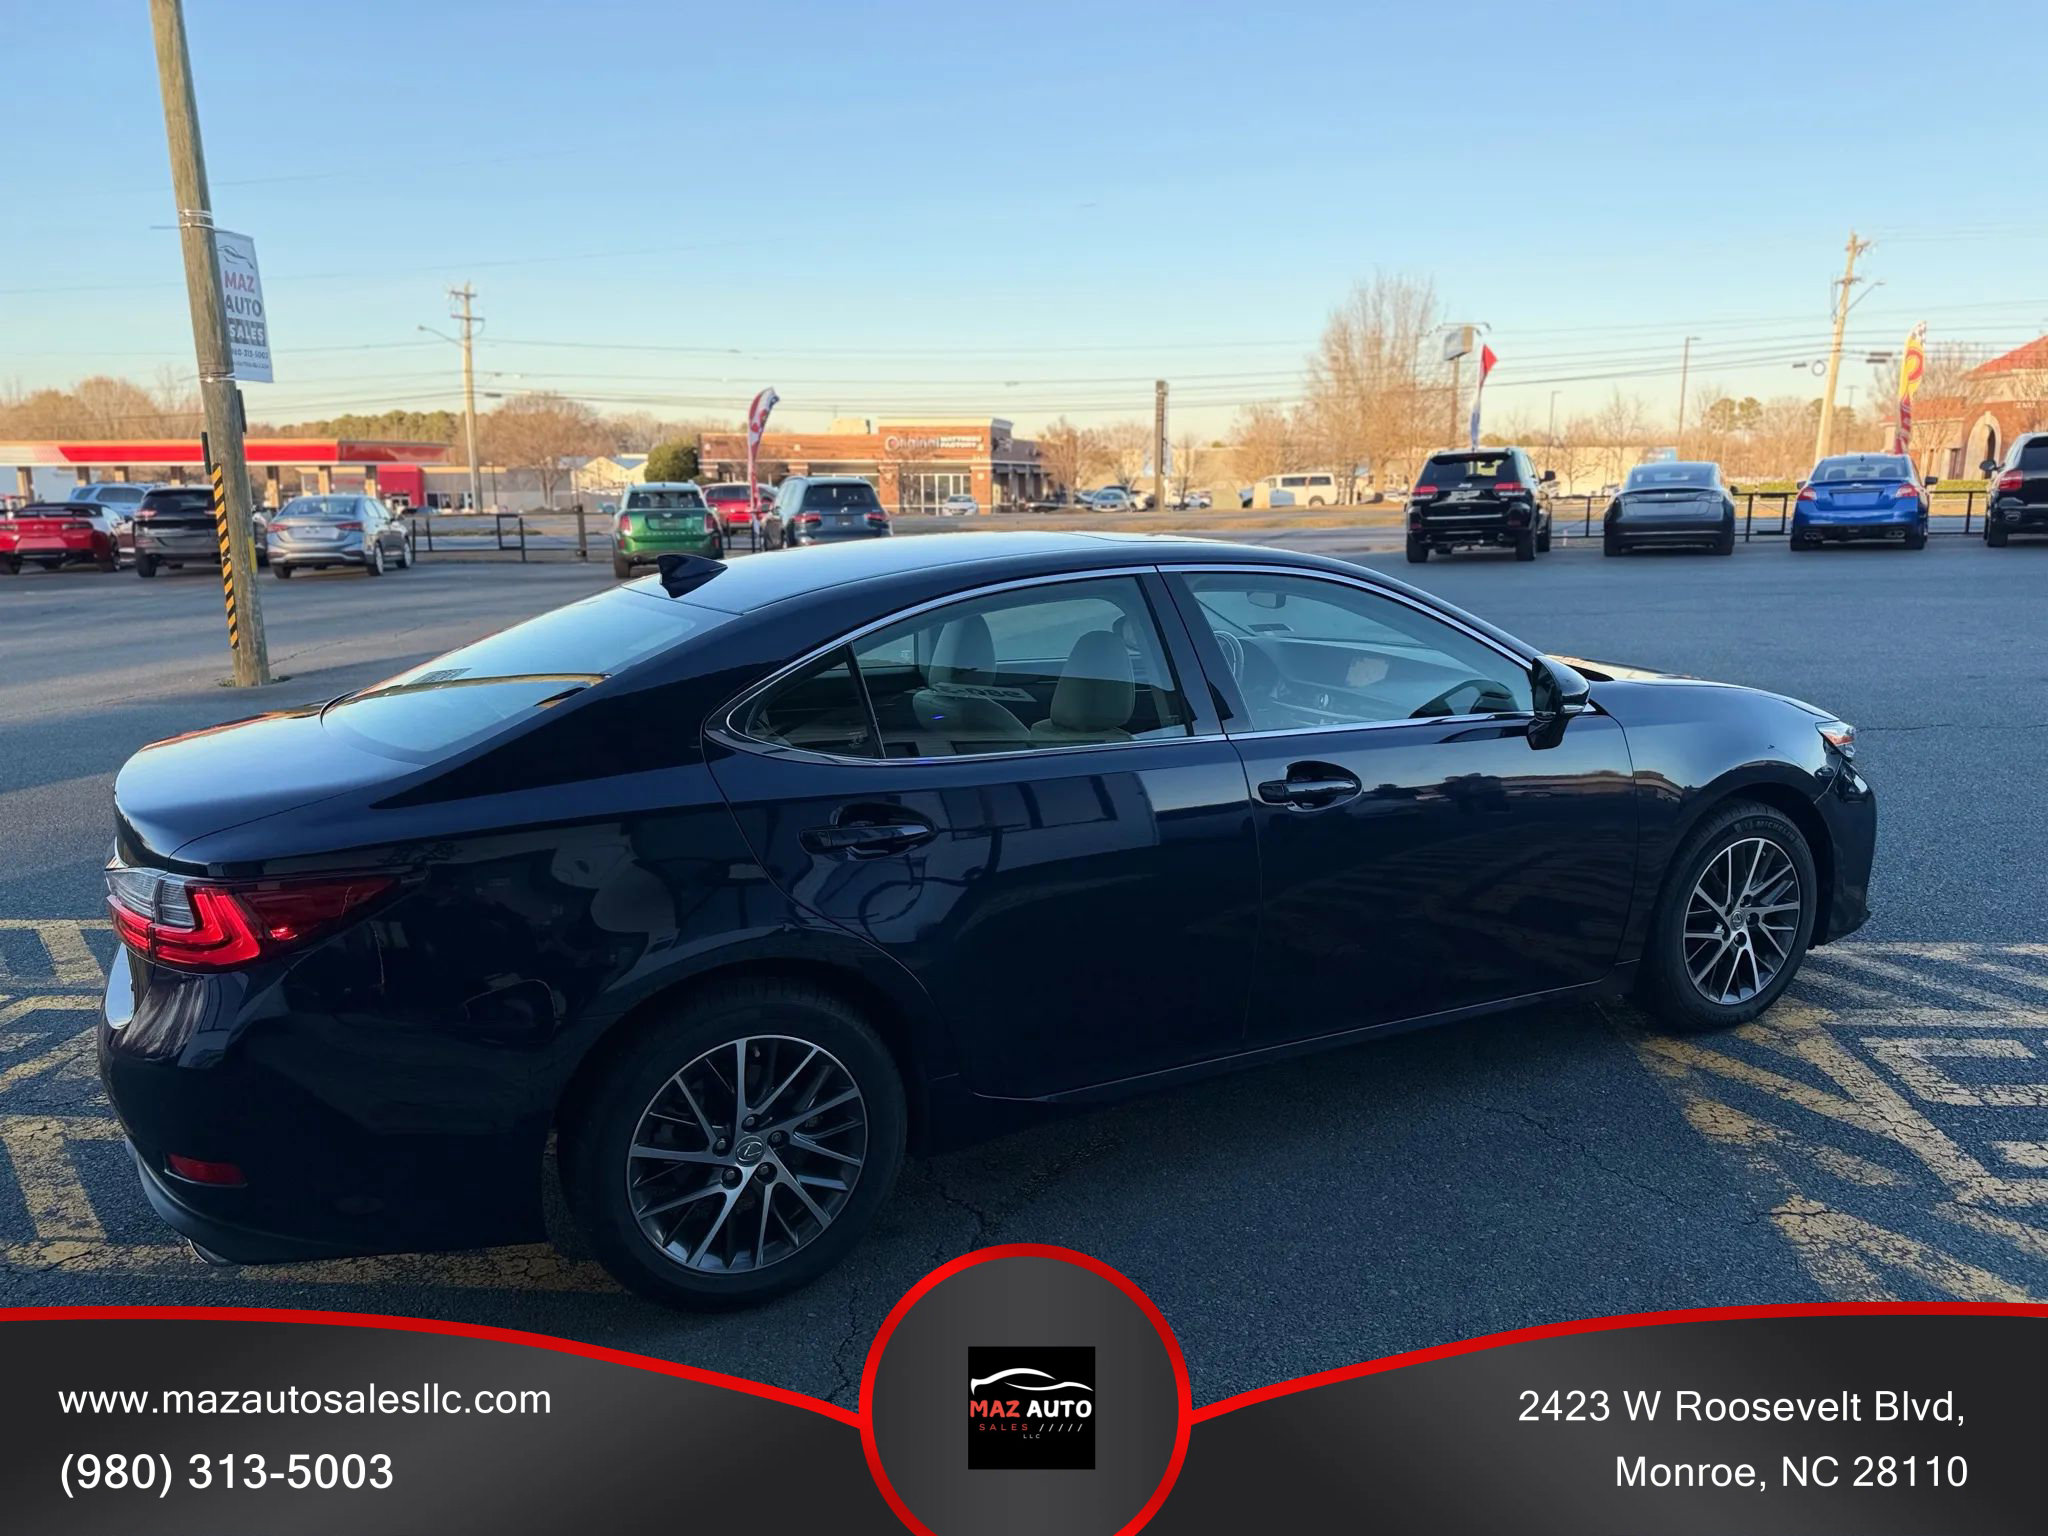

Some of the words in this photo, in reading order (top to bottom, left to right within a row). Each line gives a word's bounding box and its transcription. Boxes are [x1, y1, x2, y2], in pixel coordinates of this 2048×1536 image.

[225, 270, 255, 293] MAZ
[226, 294, 262, 317] AUTO
[229, 325, 264, 341] SALES
